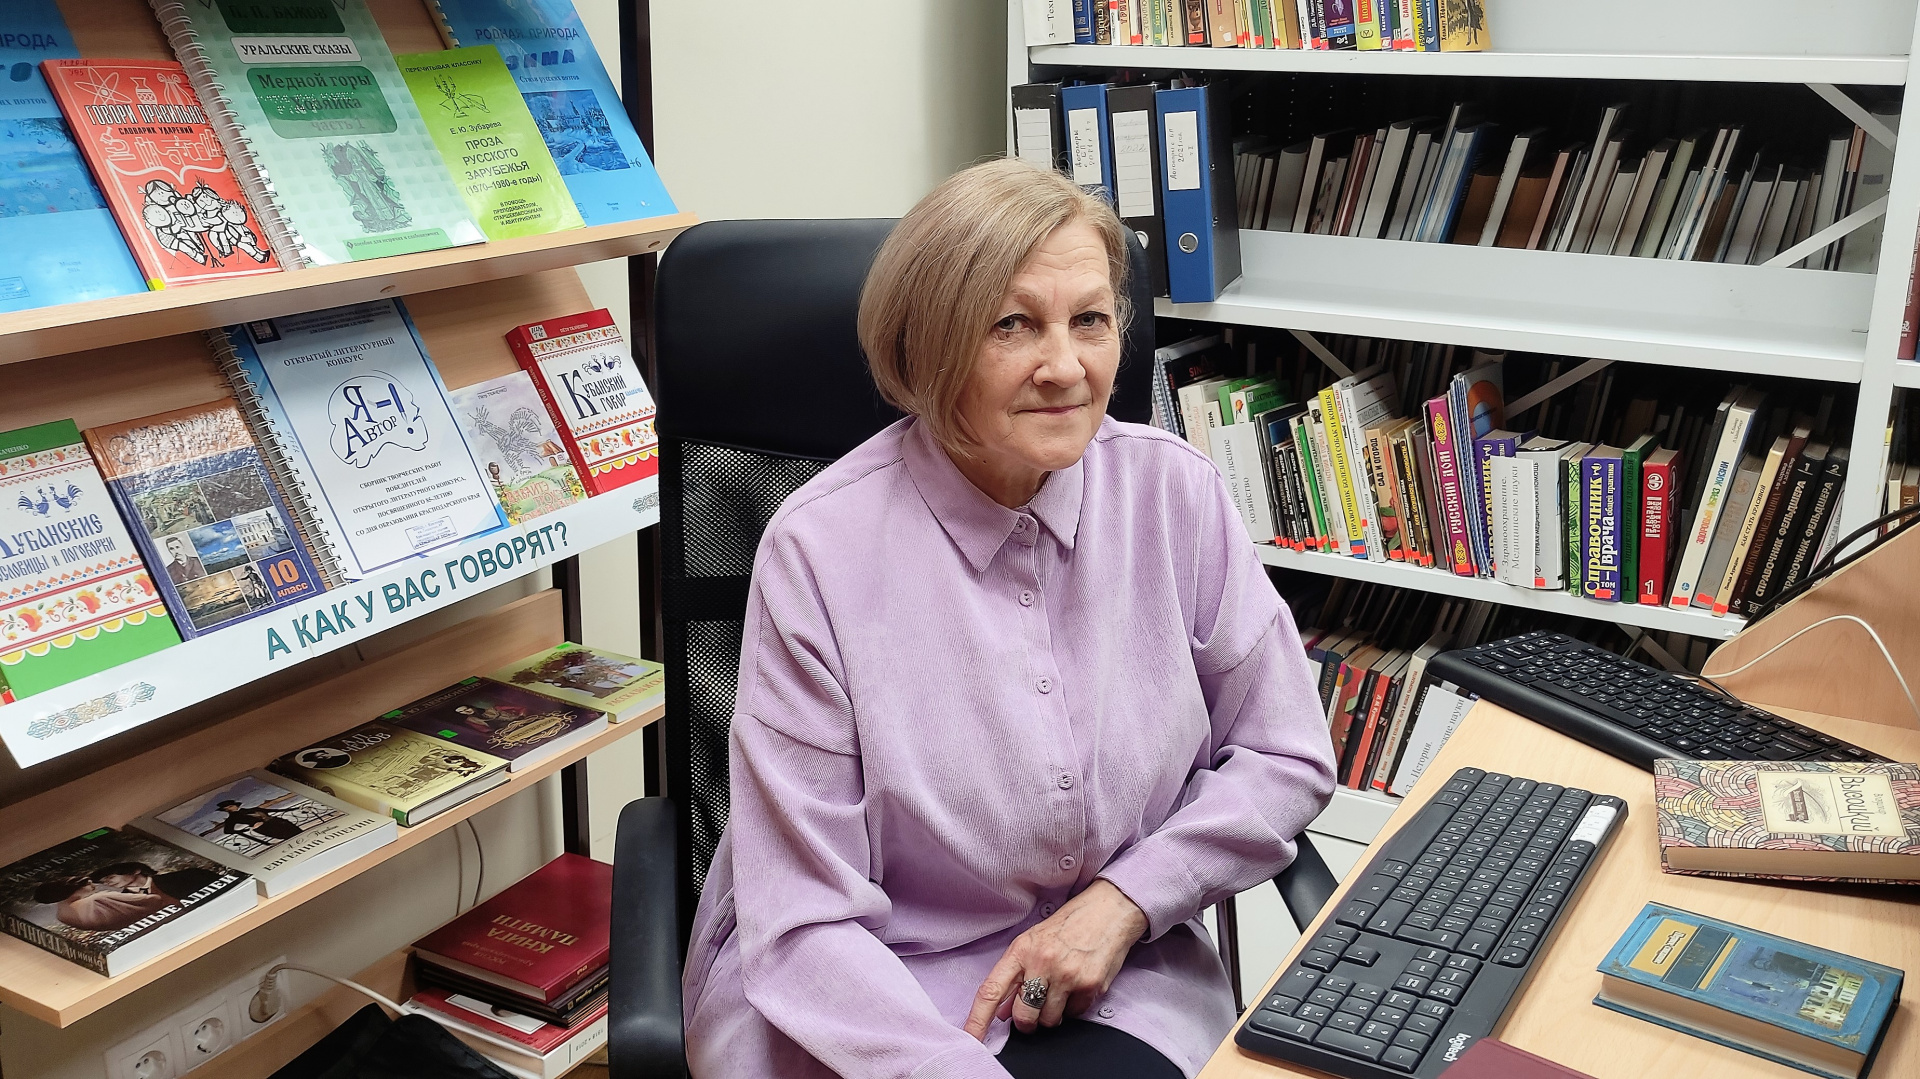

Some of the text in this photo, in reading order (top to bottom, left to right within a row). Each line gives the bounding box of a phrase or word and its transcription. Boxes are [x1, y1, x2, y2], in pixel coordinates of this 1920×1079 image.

[274, 5, 327, 19] БАЖОВ
[475, 27, 580, 40] РОДНАЯ ПРИРОДА
[240, 44, 353, 56] УРАЛЬСКИЕ СКАЗЫ
[506, 49, 575, 71] ЗИМА
[405, 59, 482, 73] ПЕРЕЧИТЫВАЯ КЛАССИКУ
[256, 73, 372, 91] Медной горы
[85, 104, 207, 125] ГОВОРИ ПРАВИЛЬНО
[312, 118, 365, 131] часть 1
[469, 122, 502, 133] Зубарева
[118, 126, 194, 135] СЛОВАРИК УДАРЕНИЙ
[465, 136, 503, 150] ПРОЗА
[462, 148, 519, 165] РУССКОГО
[465, 161, 530, 180] ЗАРУБЕЖЬЯ
[519, 173, 543, 184] годы)
[283, 337, 395, 367] ОТКРЫТЫЙ ЛИТЕРАТУРНЫЙ
[326, 353, 364, 368] КОНКУРС
[557, 370, 627, 420] КУБАНСКИЙ
[600, 392, 626, 412] ГОВОР
[1325, 394, 1335, 420] КОШЕК
[1332, 429, 1341, 452] СОБАК
[1370, 438, 1381, 463] ОГОРОД
[359, 461, 442, 490] СБОРНИК ТВОРЧЕСКИХ РАБОТ
[1336, 453, 1349, 489] БОЛЕЗНЕЙ
[1377, 472, 1385, 487] САД
[1830, 464, 1840, 474] 2
[385, 476, 427, 493] ПОБЕДИТЕЛЕЙ
[1439, 450, 1463, 534] РУССКИЙ ДОМ
[352, 498, 389, 515] ОТКРЫТОГО
[389, 485, 434, 504] ЛИТЕРАТУРНОГО
[377, 500, 426, 518] ПОСВЯЩЕННОГО
[1242, 477, 1257, 524] хозяйство
[1344, 489, 1359, 537] СПРАВОЧНИК
[1602, 463, 1617, 564] врача общей практики
[1744, 516, 1755, 535] СТАТЬ
[1750, 484, 1767, 515] КРАСИВОЙ
[356, 493, 481, 537] СО ДНЯ ОБРАЗОВАНИЯ КРАСНОДАРСКОГО КРАЯ
[1501, 476, 1509, 566] Здравоохранение.
[1511, 465, 1520, 569] Медицинские науки
[1696, 510, 1712, 545] ЗДОРОВЫЙ
[1584, 477, 1617, 595] Справочник
[1756, 537, 1784, 597] СПРАВОЧНИК
[1775, 479, 1807, 536] ФЕЛЬДШЕРА
[1782, 538, 1811, 591] ПРАВОЧНИК
[1803, 481, 1834, 537] ФЕЛЬДШЕРА
[53, 537, 117, 567] и ПОГОВОРКИ
[268, 558, 300, 588] 10
[1624, 577, 1632, 591] 1
[267, 627, 292, 661] А
[292, 600, 357, 648] КАК
[355, 590, 374, 623] У
[382, 569, 441, 614] ВАС
[444, 521, 569, 590] ГОВОРЯТ?
[277, 583, 309, 598] класс
[1645, 580, 1653, 595] 1
[342, 733, 391, 752] ЧЕХОВ
[1410, 741, 1432, 778] История.
[1838, 775, 1874, 832] Высоцкий
[263, 817, 376, 873] ЕВГЕНИЙ ОНЕГИН
[8, 862, 48, 884] Иван
[99, 872, 241, 949] ТЕМНЫЕ АЛЛЕИ
[8, 916, 62, 954] ТЕМНЫЕ
[486, 927, 555, 955] КНИГА
[491, 914, 579, 947] ПАМЯТИ
[1442, 1033, 1472, 1062] logitech
